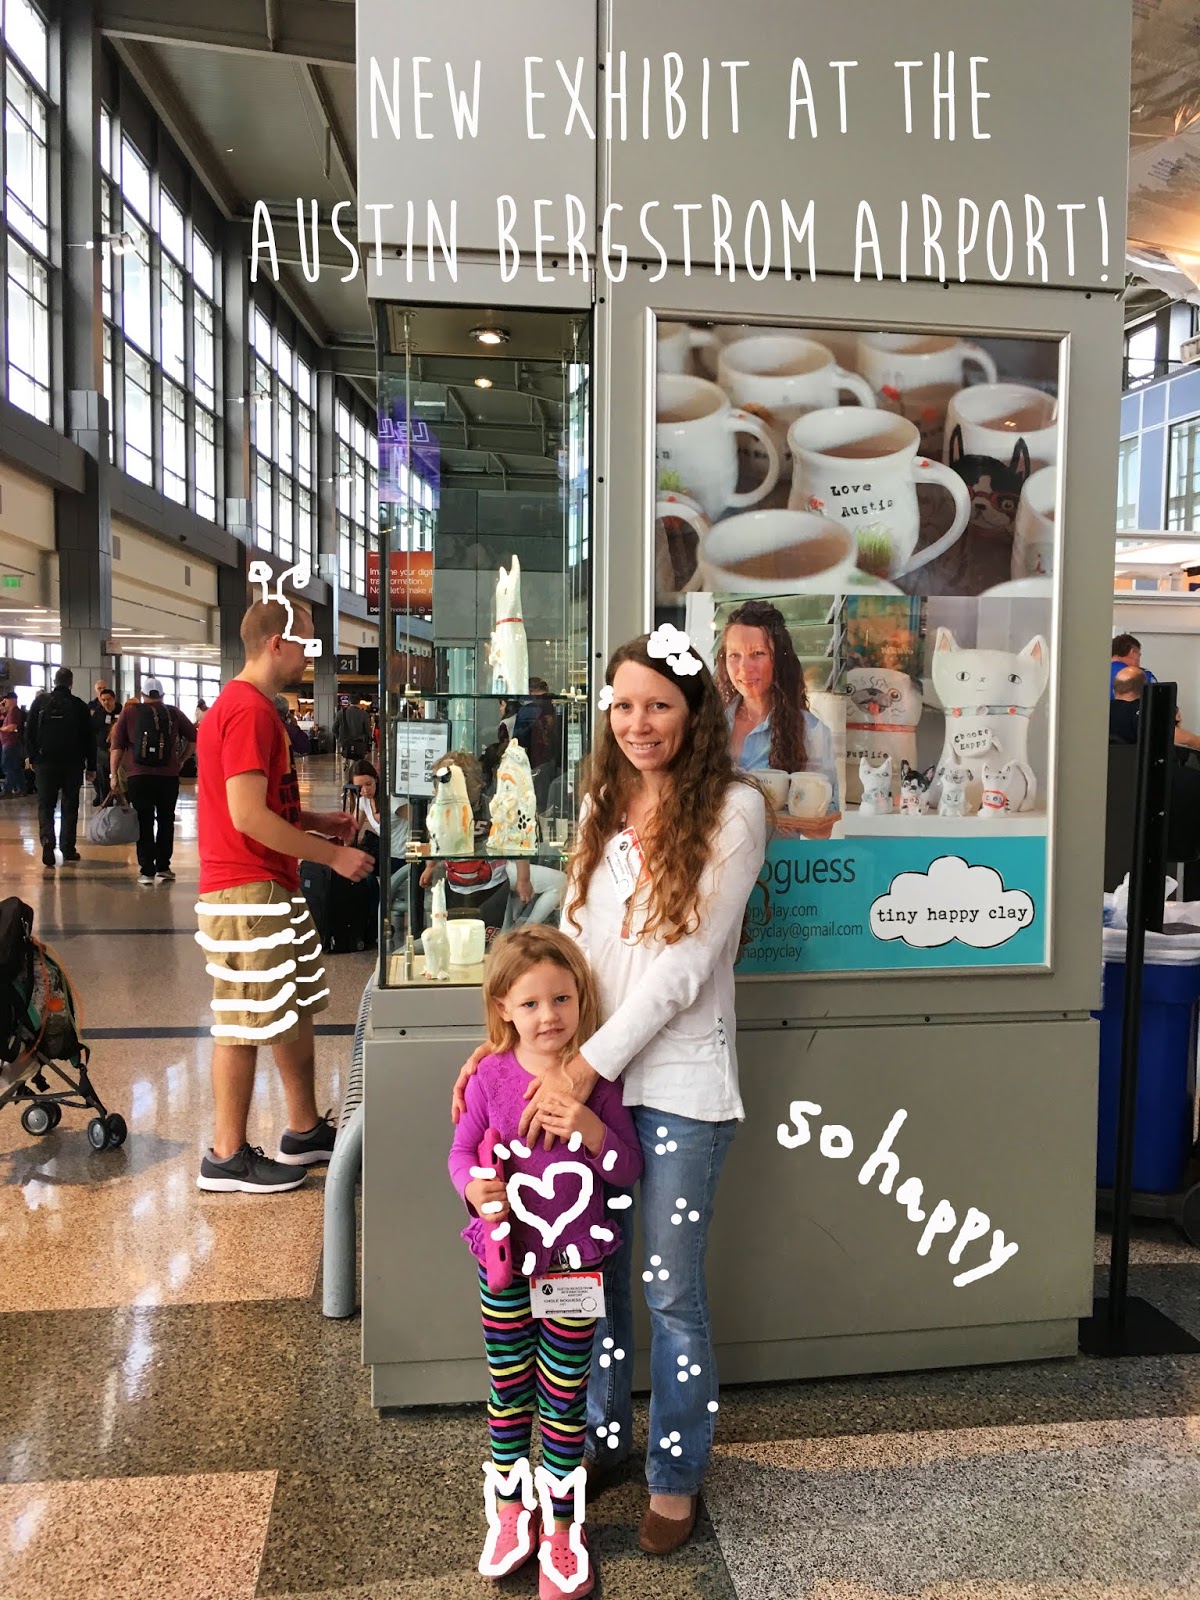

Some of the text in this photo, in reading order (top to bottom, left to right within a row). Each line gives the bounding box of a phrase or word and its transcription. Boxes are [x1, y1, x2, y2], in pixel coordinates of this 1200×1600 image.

[830, 483, 872, 496] Love
[340, 659, 354, 671] 21
[877, 906, 1028, 924] tiny happy clay
